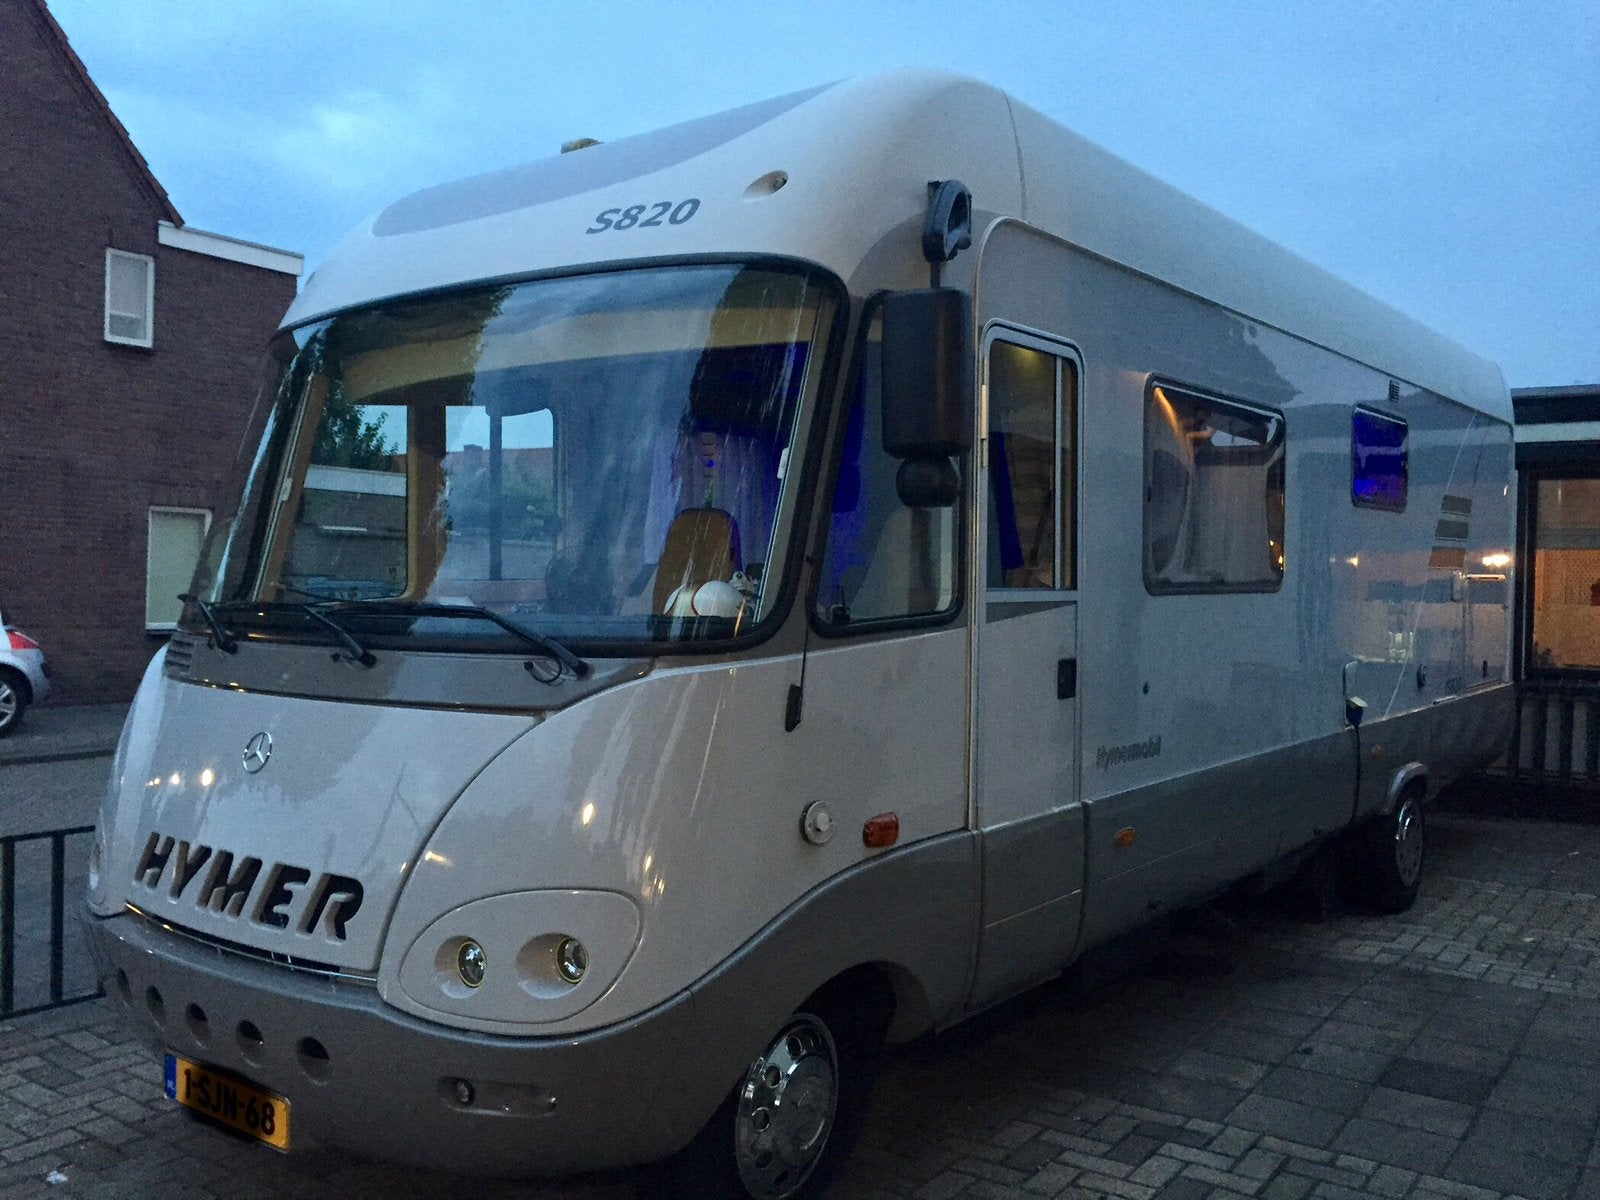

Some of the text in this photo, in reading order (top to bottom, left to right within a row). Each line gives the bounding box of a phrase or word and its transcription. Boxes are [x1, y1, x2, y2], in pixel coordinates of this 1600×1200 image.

[585, 198, 701, 235] S820
[134, 831, 365, 941] HYMER
[184, 1067, 276, 1136] 1-SJN-68
